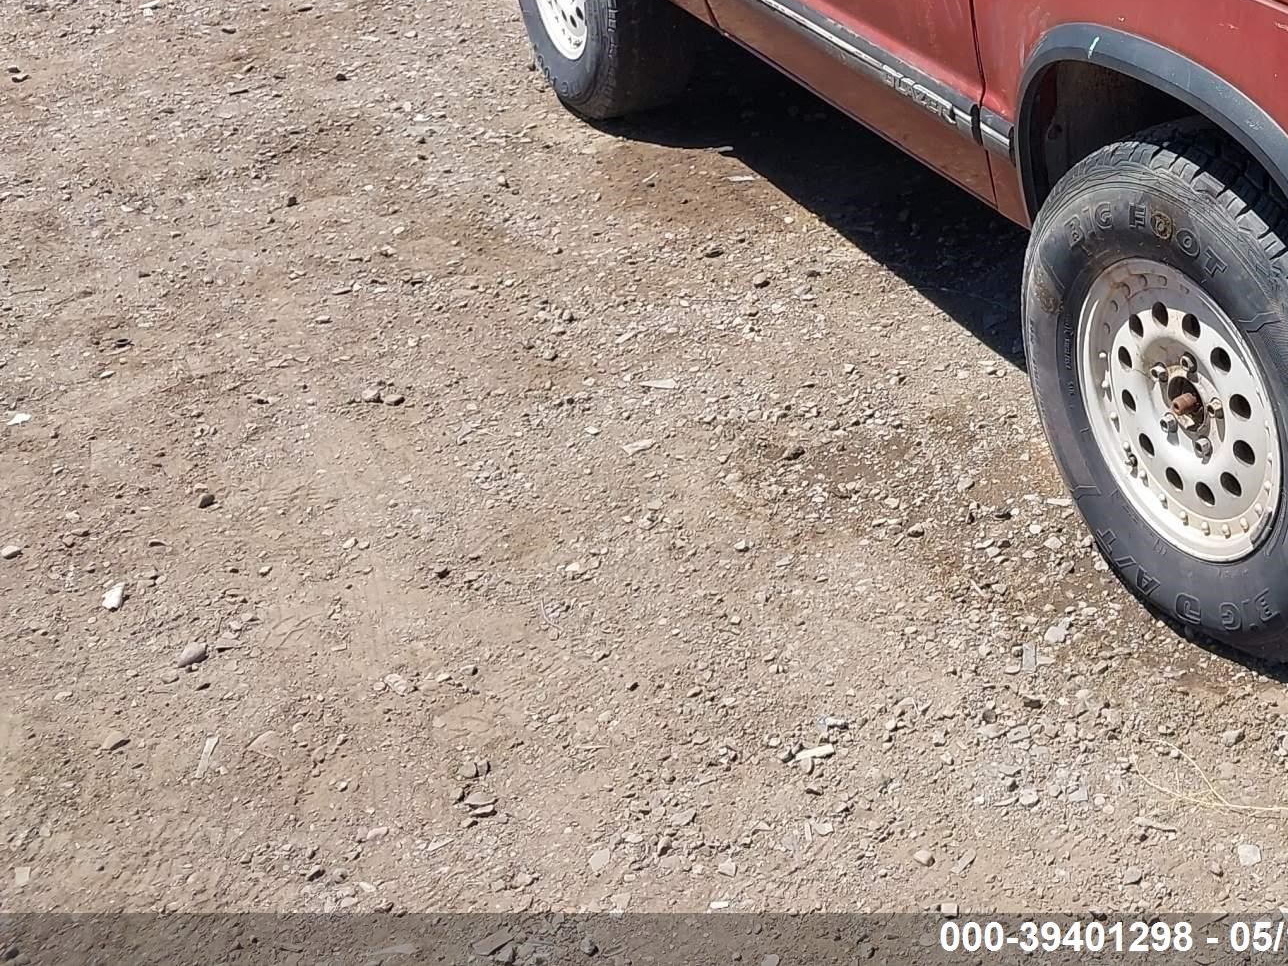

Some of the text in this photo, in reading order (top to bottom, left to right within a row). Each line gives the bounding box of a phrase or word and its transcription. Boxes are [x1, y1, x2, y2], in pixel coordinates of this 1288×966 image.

[1063, 201, 1228, 277] BIG FOOT
[1218, 588, 1280, 632] BIG
